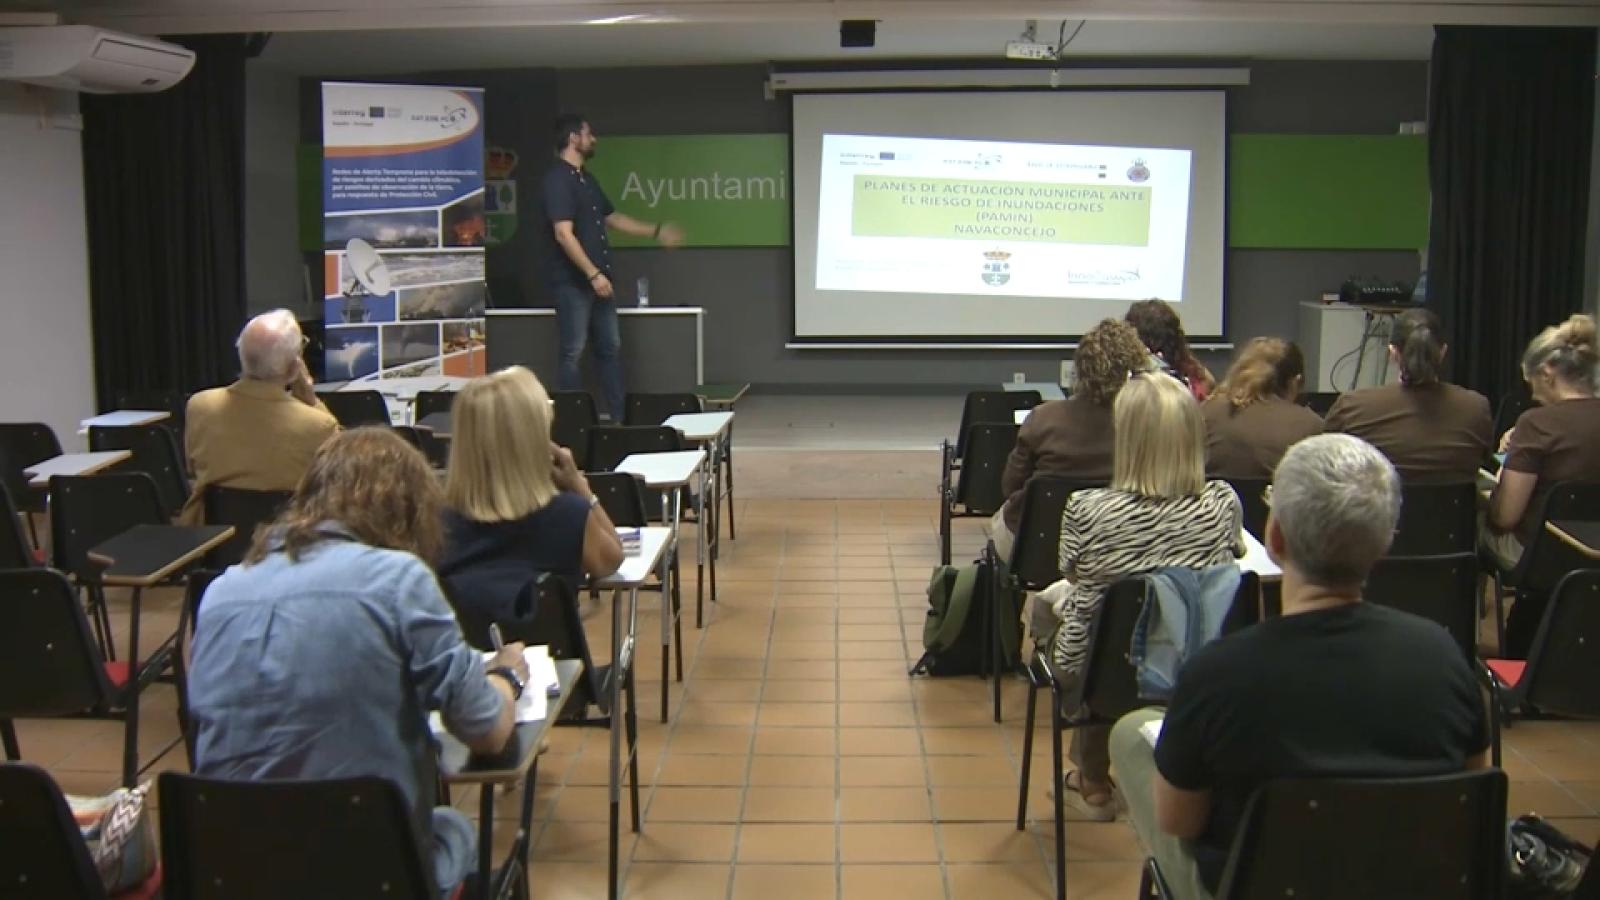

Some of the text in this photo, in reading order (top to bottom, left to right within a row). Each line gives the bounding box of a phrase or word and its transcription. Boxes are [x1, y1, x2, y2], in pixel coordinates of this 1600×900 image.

[864, 180, 916, 192] PLANES
[920, 183, 940, 194] DE
[1029, 188, 1105, 200] MUNICIPAL
[1109, 191, 1146, 201] ANTE
[902, 195, 1104, 213] EL RIESGO DE INUNDACIONES
[954, 224, 1056, 237] NAVACONCEJO
